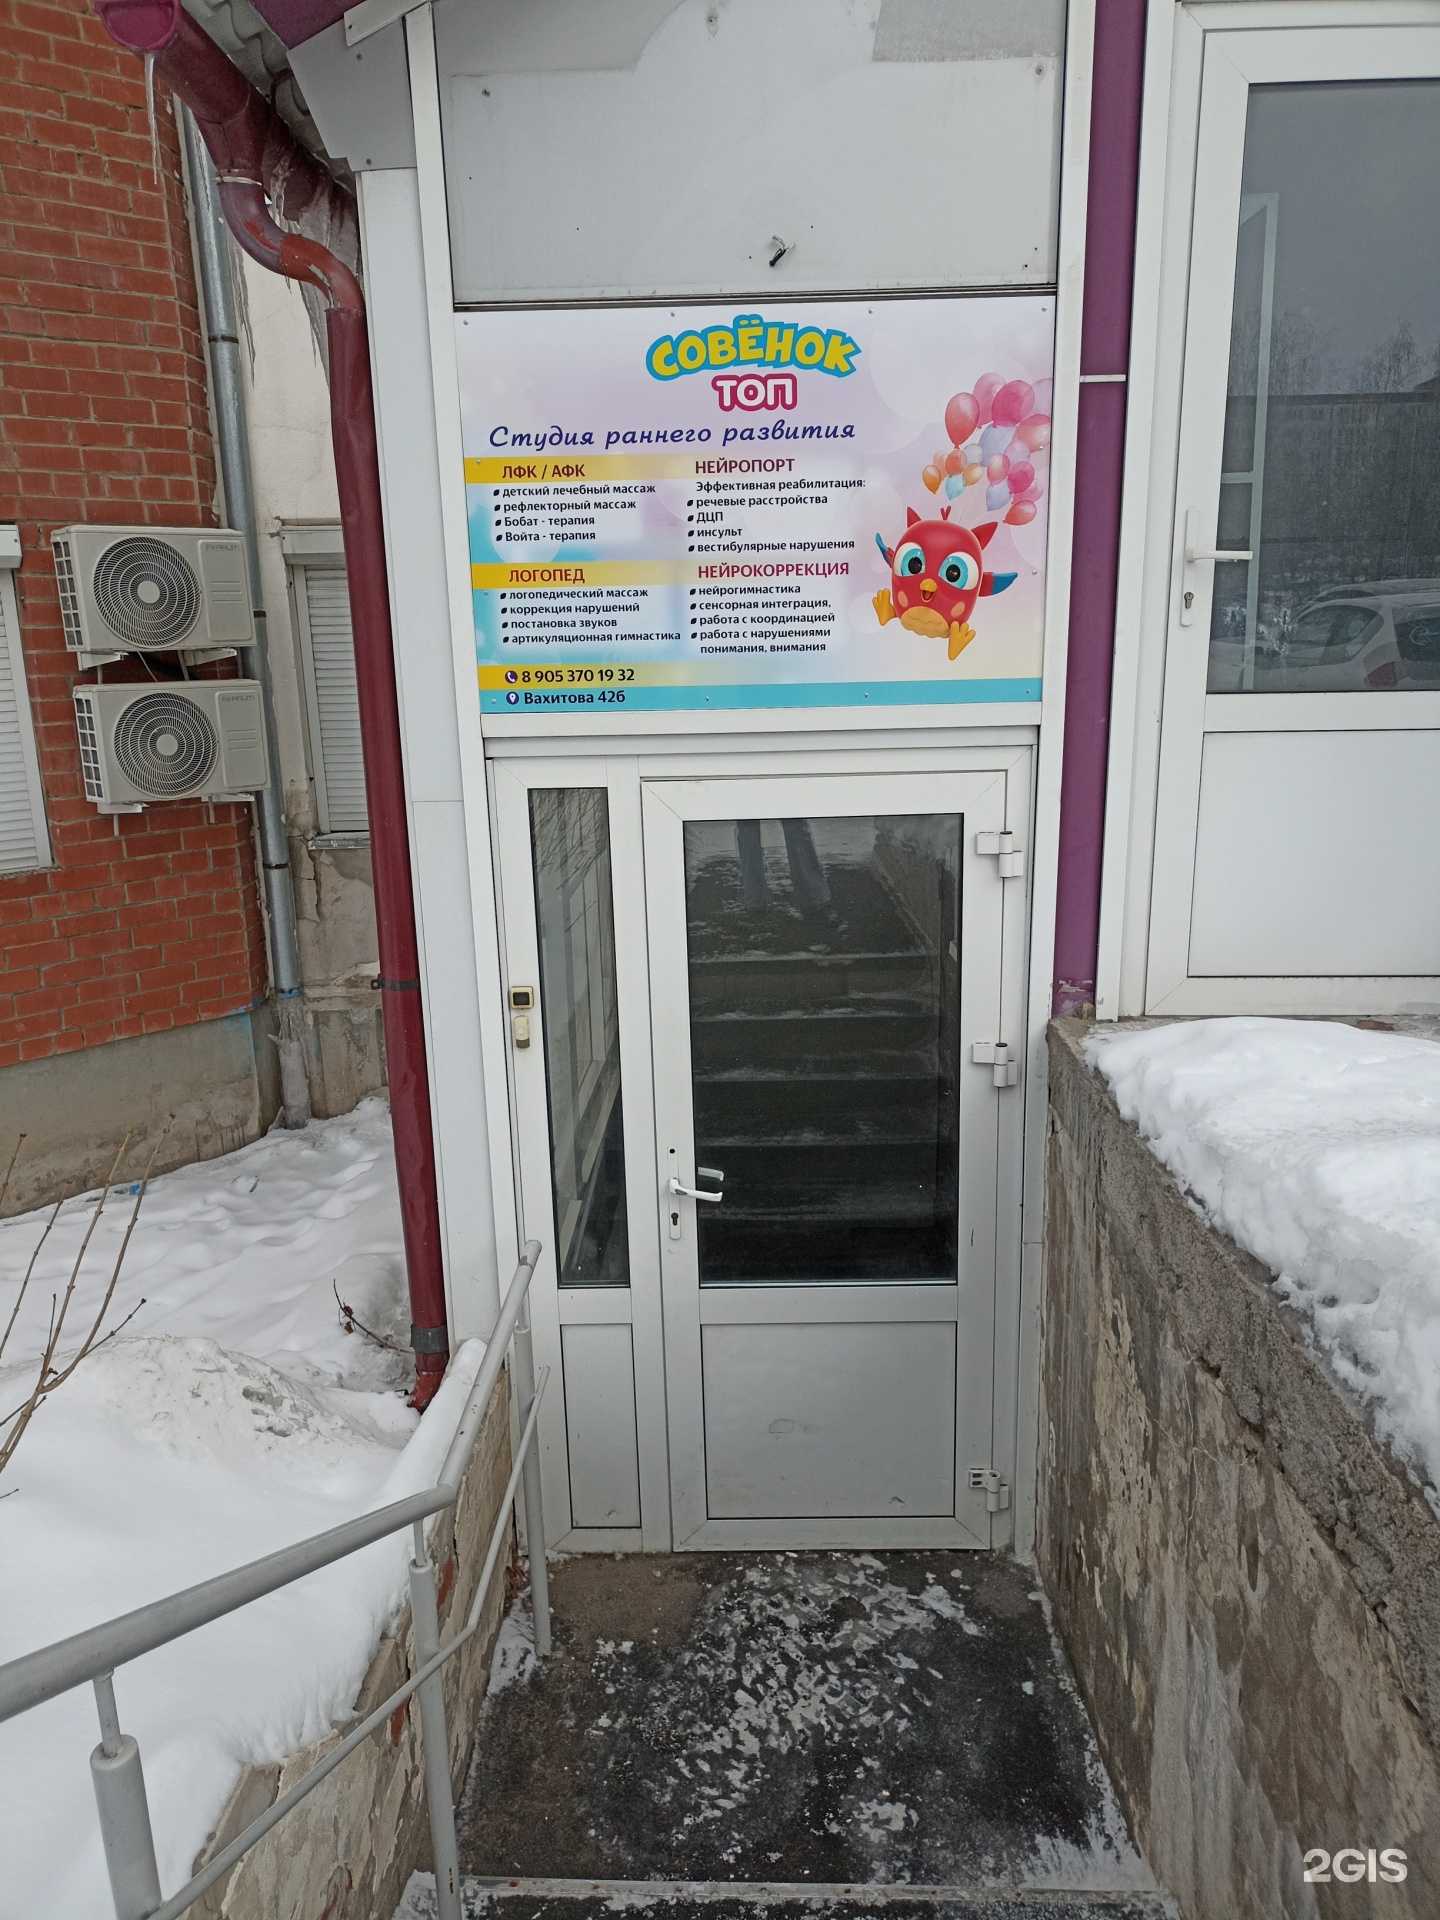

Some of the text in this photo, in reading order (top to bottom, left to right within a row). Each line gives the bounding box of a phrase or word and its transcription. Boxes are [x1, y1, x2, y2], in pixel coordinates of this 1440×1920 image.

[648, 316, 860, 378] СОВЁНОК
[713, 375, 797, 411] ТОП
[489, 419, 855, 451] Студия раннего развития
[502, 464, 586, 480] ЛФК / АФК
[695, 457, 796, 474] НЕЙРОПОРТ
[502, 483, 656, 497] детский лечебный массаж
[696, 478, 867, 494] Эффективная реабилитация:
[503, 500, 637, 513] рефлекторный массаж
[696, 494, 828, 508] речевые расстройства
[504, 517, 538, 527] Бобат
[548, 517, 595, 527] терапия
[697, 511, 724, 524] ДЦП
[505, 532, 540, 542] Войта
[549, 531, 596, 543] терапия
[697, 528, 742, 539] инсульт
[697, 540, 855, 552] вестибулярные нарушения
[508, 568, 585, 583] ЛОГОПЕД
[698, 562, 849, 579] НЕЙРОКОРРЕКЦИЯ
[508, 588, 649, 600] логопедический массаж
[699, 584, 801, 597] нейрогимнастика
[510, 602, 640, 616] коррекция нарушений
[699, 602, 759, 612] сенсорная
[511, 618, 617, 630] постановка звуков
[700, 612, 835, 626] работа с координацией
[511, 631, 681, 645] артикуляционная гимнастика
[700, 628, 740, 641] работа
[750, 628, 831, 641] нарушениями
[770, 643, 826, 652] внимания
[521, 668, 635, 683] 8 905 370 19 32
[524, 692, 594, 705] Вахитова
